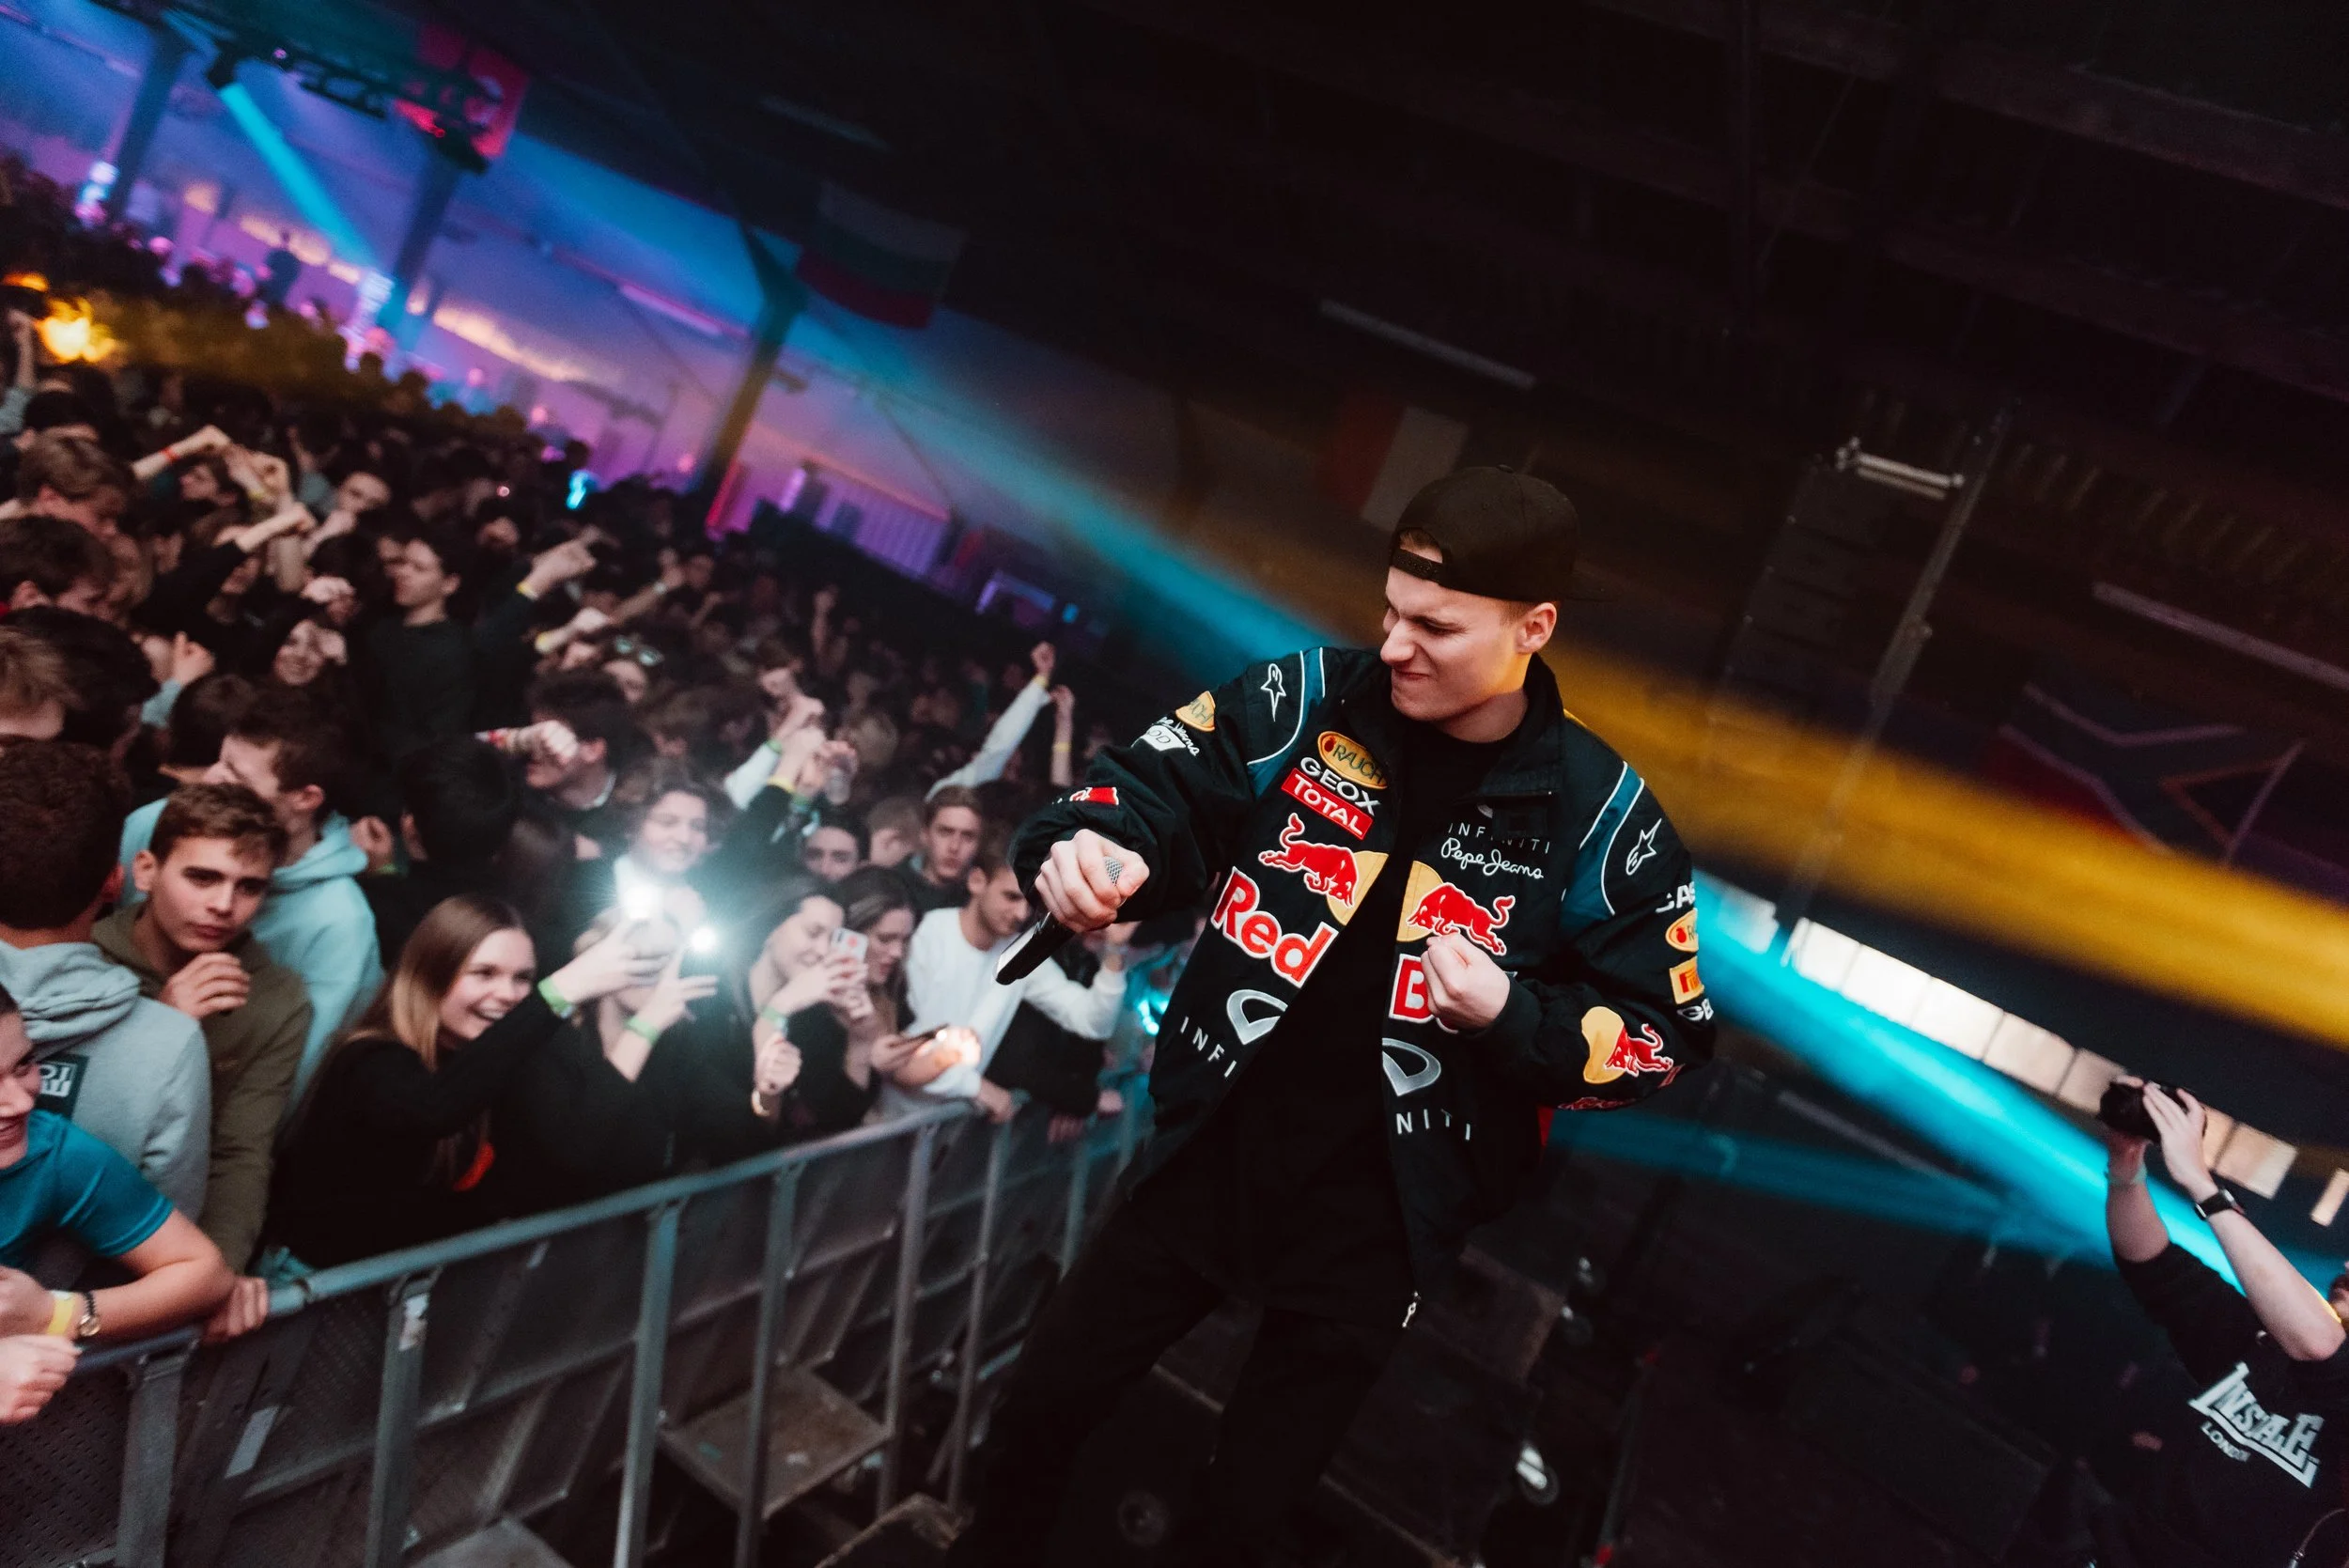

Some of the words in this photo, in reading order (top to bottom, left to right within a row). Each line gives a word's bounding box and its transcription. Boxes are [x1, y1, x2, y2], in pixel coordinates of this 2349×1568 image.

[1300, 756, 1381, 816] GEOX
[1332, 744, 1383, 784] RAUCH
[1294, 773, 1363, 836] TOTAL
[1440, 837, 1486, 870] Pepe
[1482, 848, 1544, 879] Jeans
[1210, 866, 1340, 988] Red
[1180, 1016, 1237, 1078] INFI
[1395, 1109, 1471, 1141] NITI
